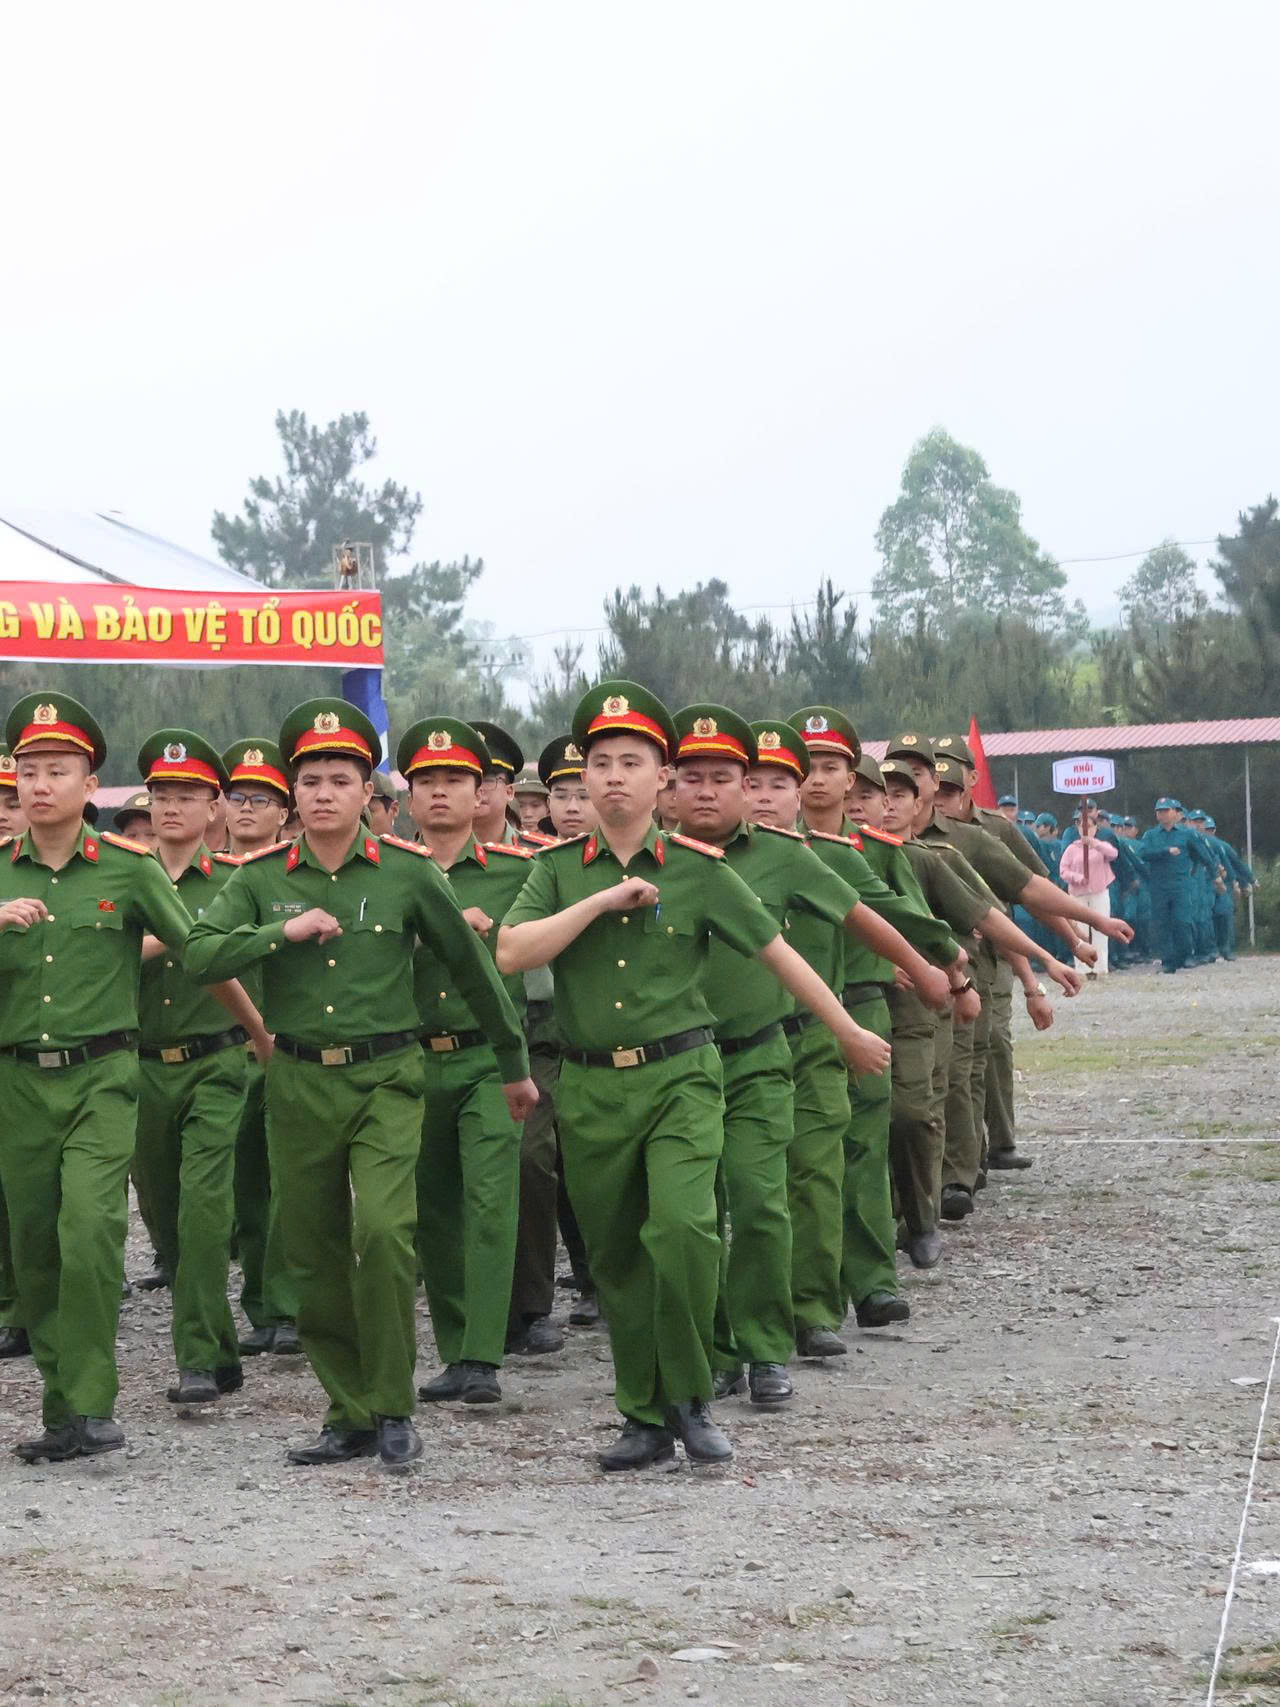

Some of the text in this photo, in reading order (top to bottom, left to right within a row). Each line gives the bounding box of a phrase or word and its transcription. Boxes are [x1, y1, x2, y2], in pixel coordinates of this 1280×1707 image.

[28, 596, 85, 641] VÀ
[93, 594, 174, 642] BẢO
[182, 600, 228, 651] VỆ
[238, 595, 282, 645] TỔ
[291, 600, 383, 649] QUỐC
